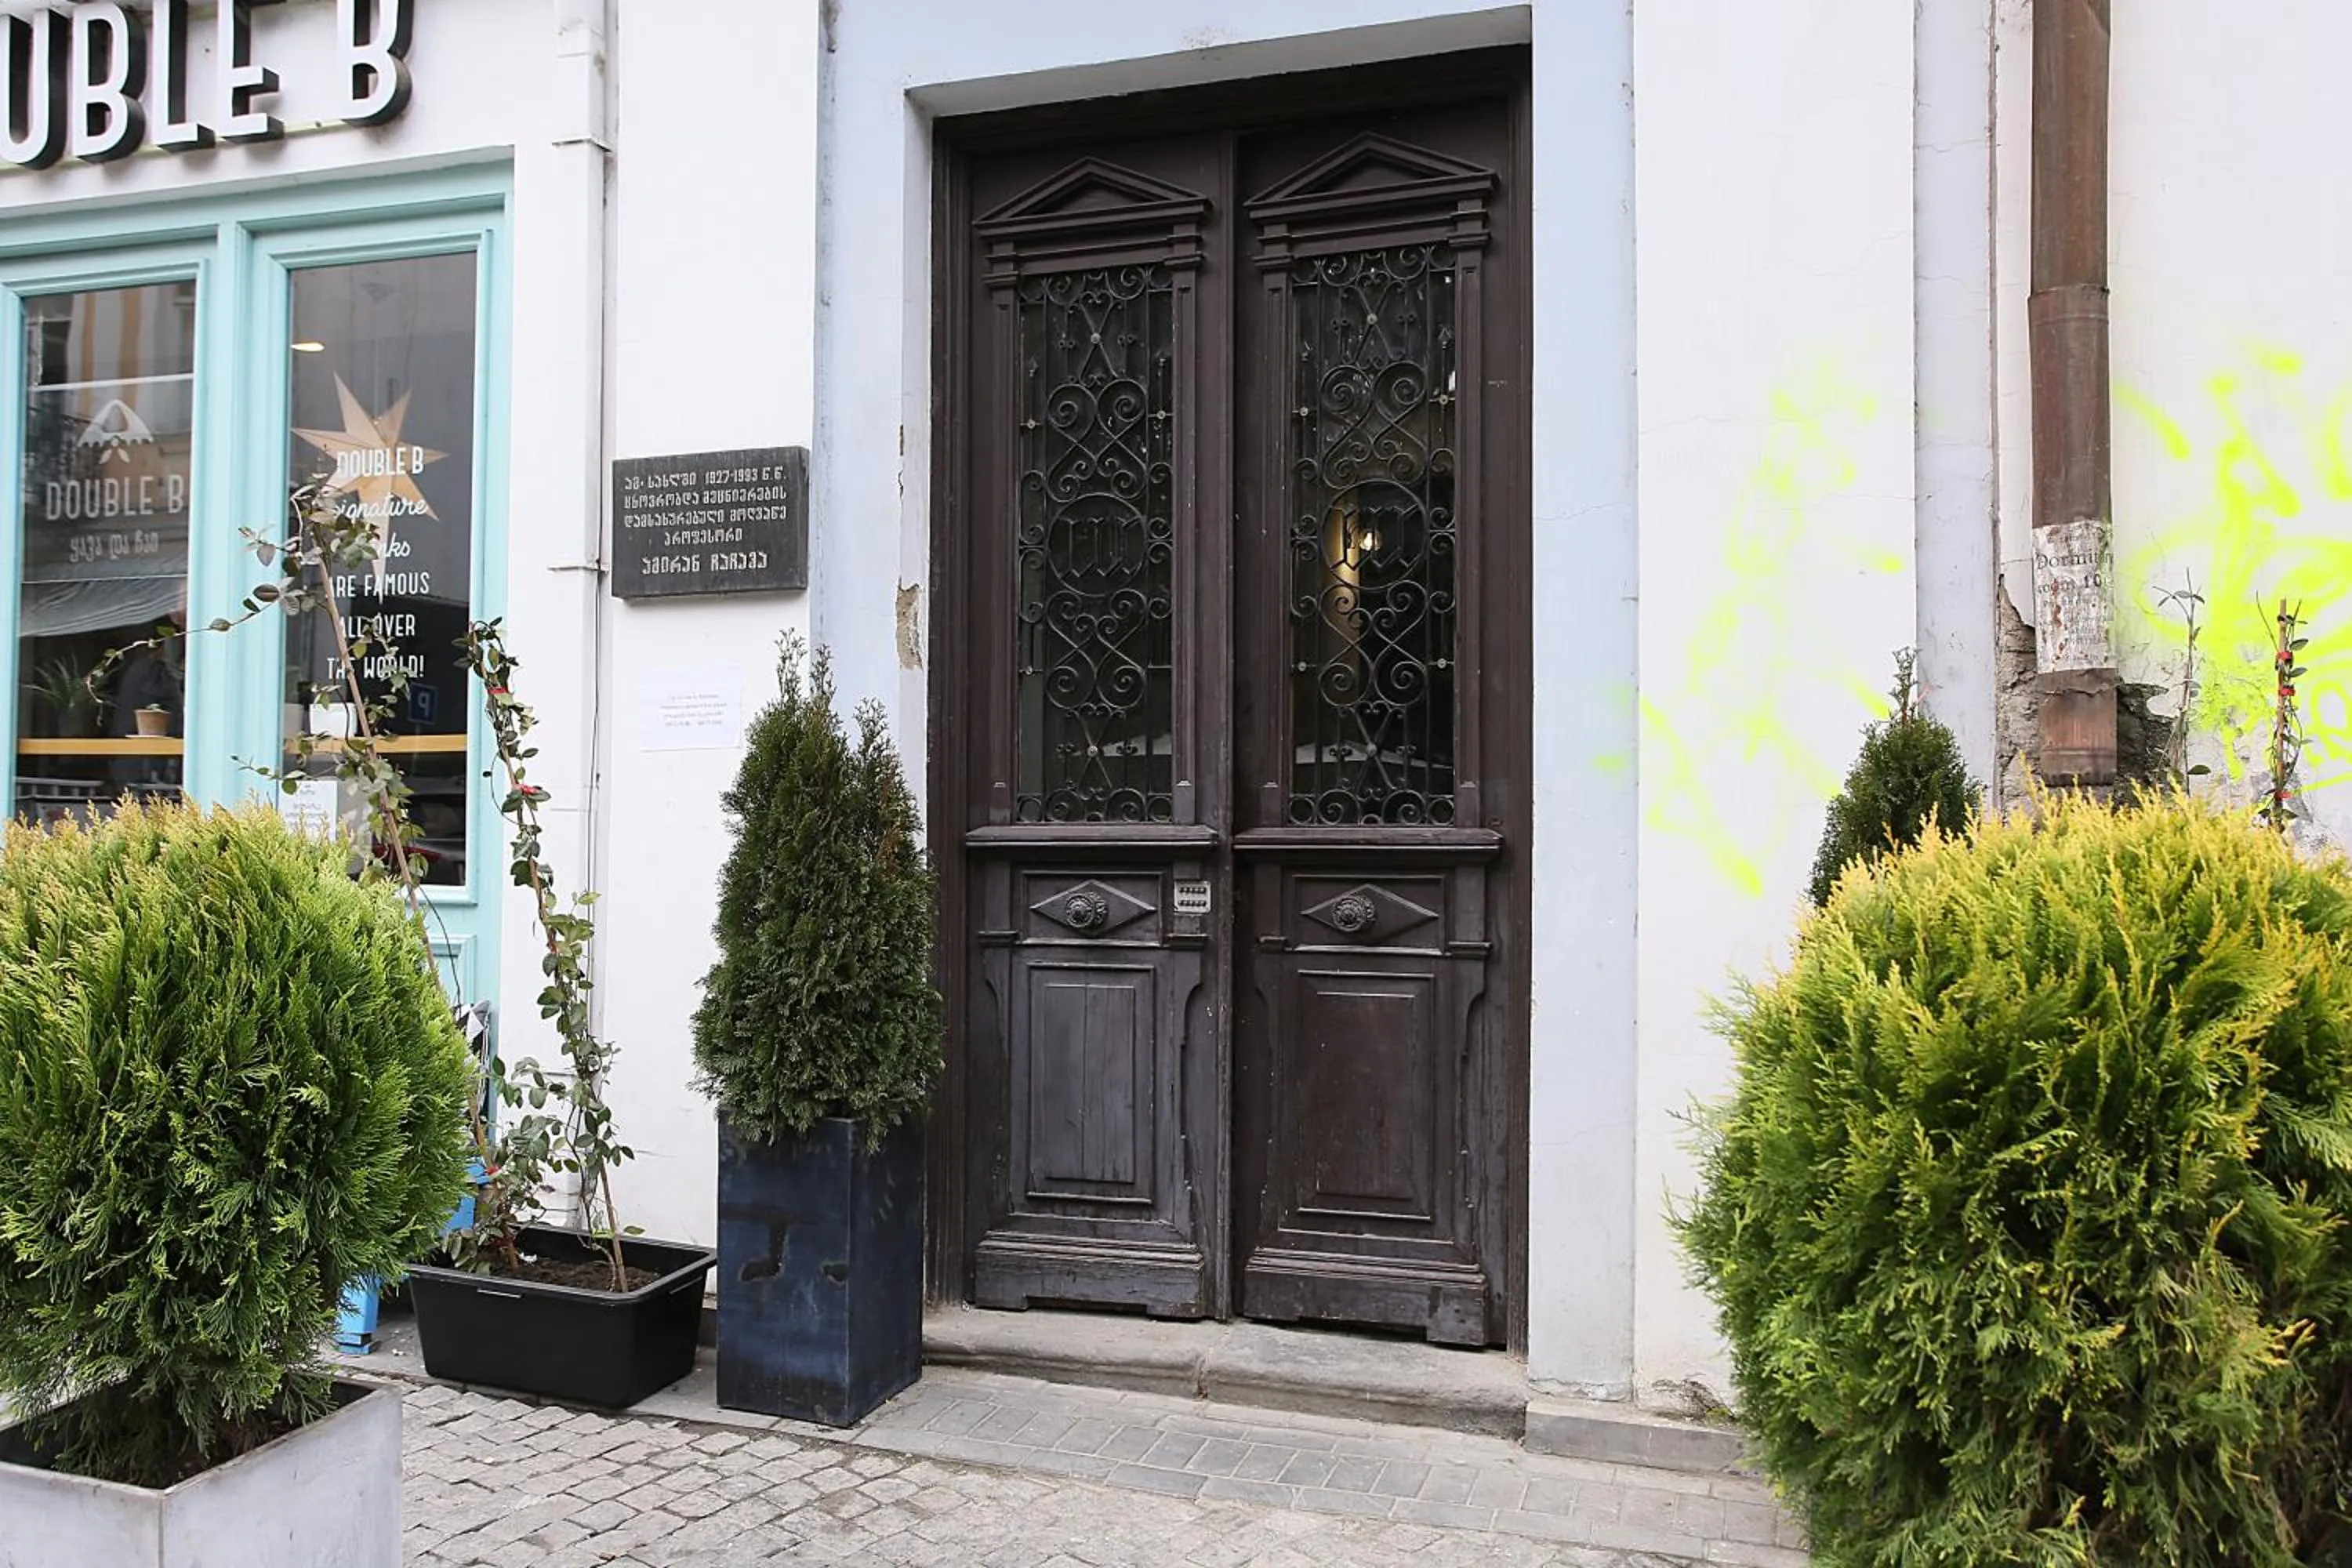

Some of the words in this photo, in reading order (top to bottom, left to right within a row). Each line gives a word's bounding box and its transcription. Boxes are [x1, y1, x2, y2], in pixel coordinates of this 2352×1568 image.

[339, 0, 411, 125] B
[337, 447, 407, 478] DOUBLE
[412, 445, 424, 474] B
[648, 472, 697, 489] სახლში
[45, 476, 154, 521] DOUBLE
[168, 474, 184, 514] B
[624, 492, 699, 509] ცხოვრობდა
[703, 486, 786, 504] მეცნიერების
[623, 510, 724, 528] დამსახურებული
[730, 506, 786, 521] მოღვაწე
[70, 535, 103, 563] ყავა
[110, 534, 129, 560] და
[664, 528, 742, 546] პროფესორი
[642, 554, 700, 575] ამირან
[365, 572, 430, 597] FAMOUS
[373, 614, 416, 637] OVER
[327, 657, 355, 679] TH
